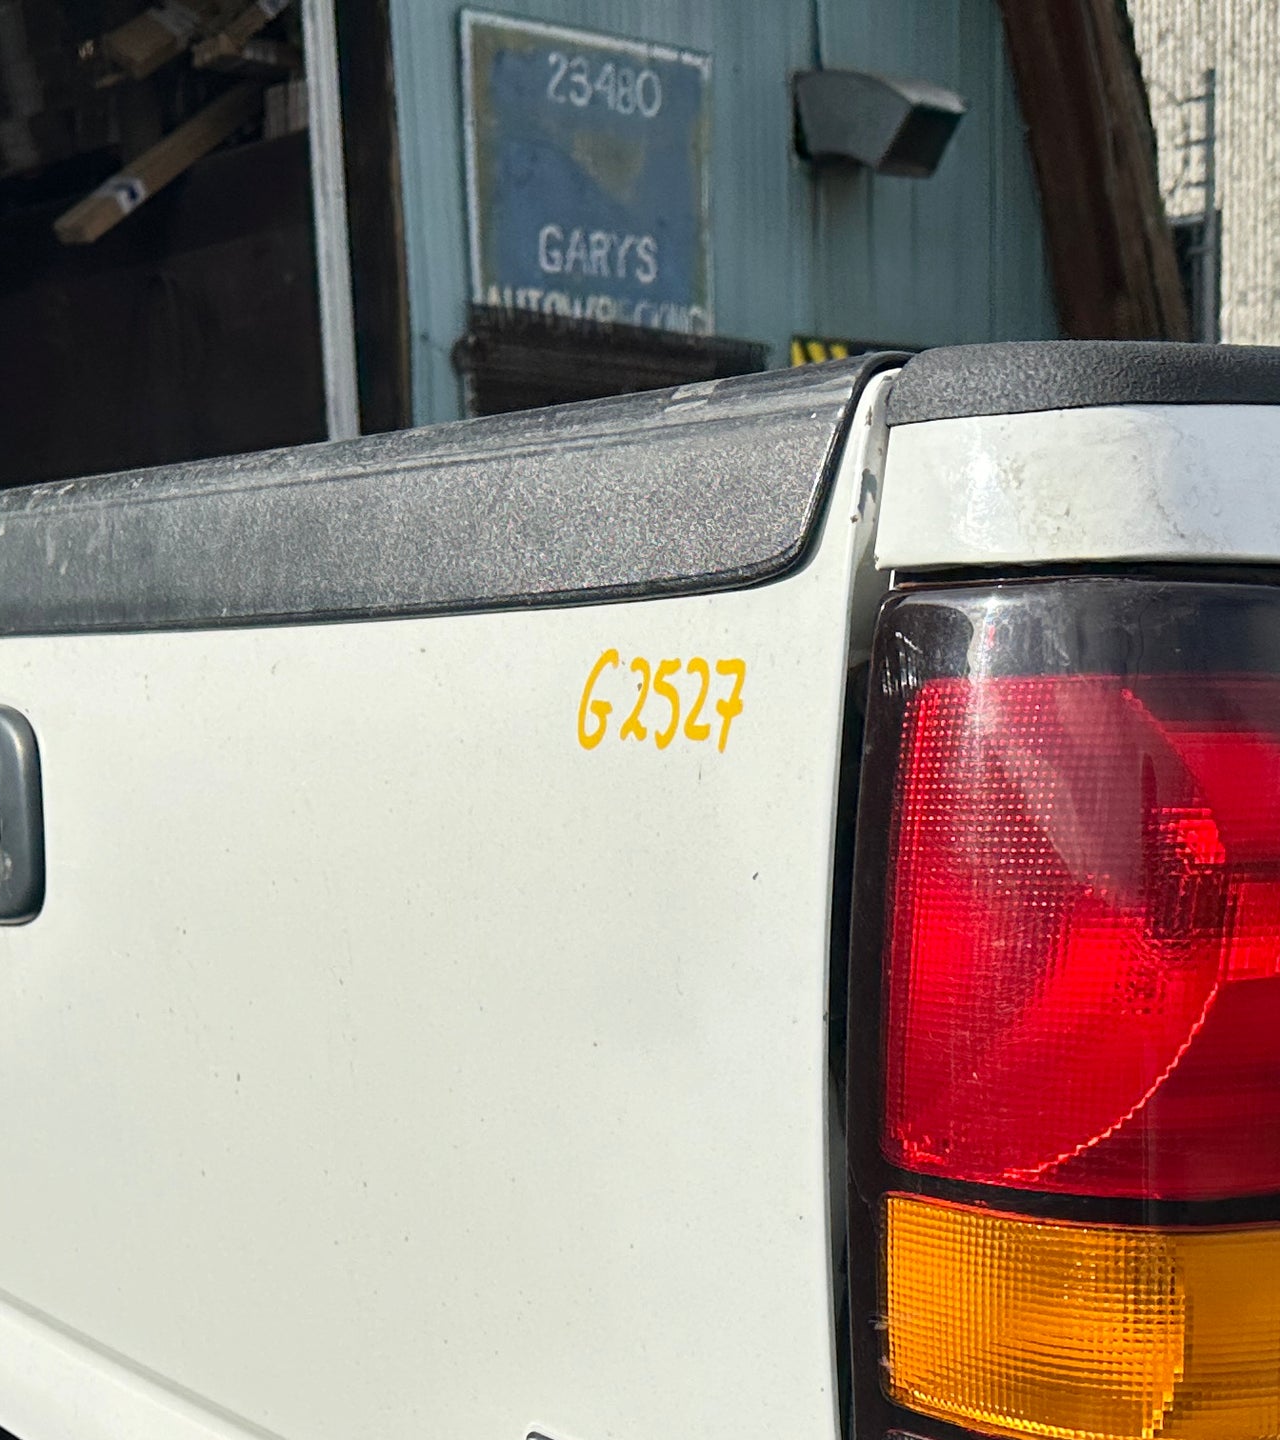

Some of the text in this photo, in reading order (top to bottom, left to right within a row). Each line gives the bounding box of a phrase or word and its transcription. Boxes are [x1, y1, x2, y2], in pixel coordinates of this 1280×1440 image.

[546, 51, 662, 118] 23480
[539, 224, 658, 283] GARYS
[578, 648, 746, 753] G2527
